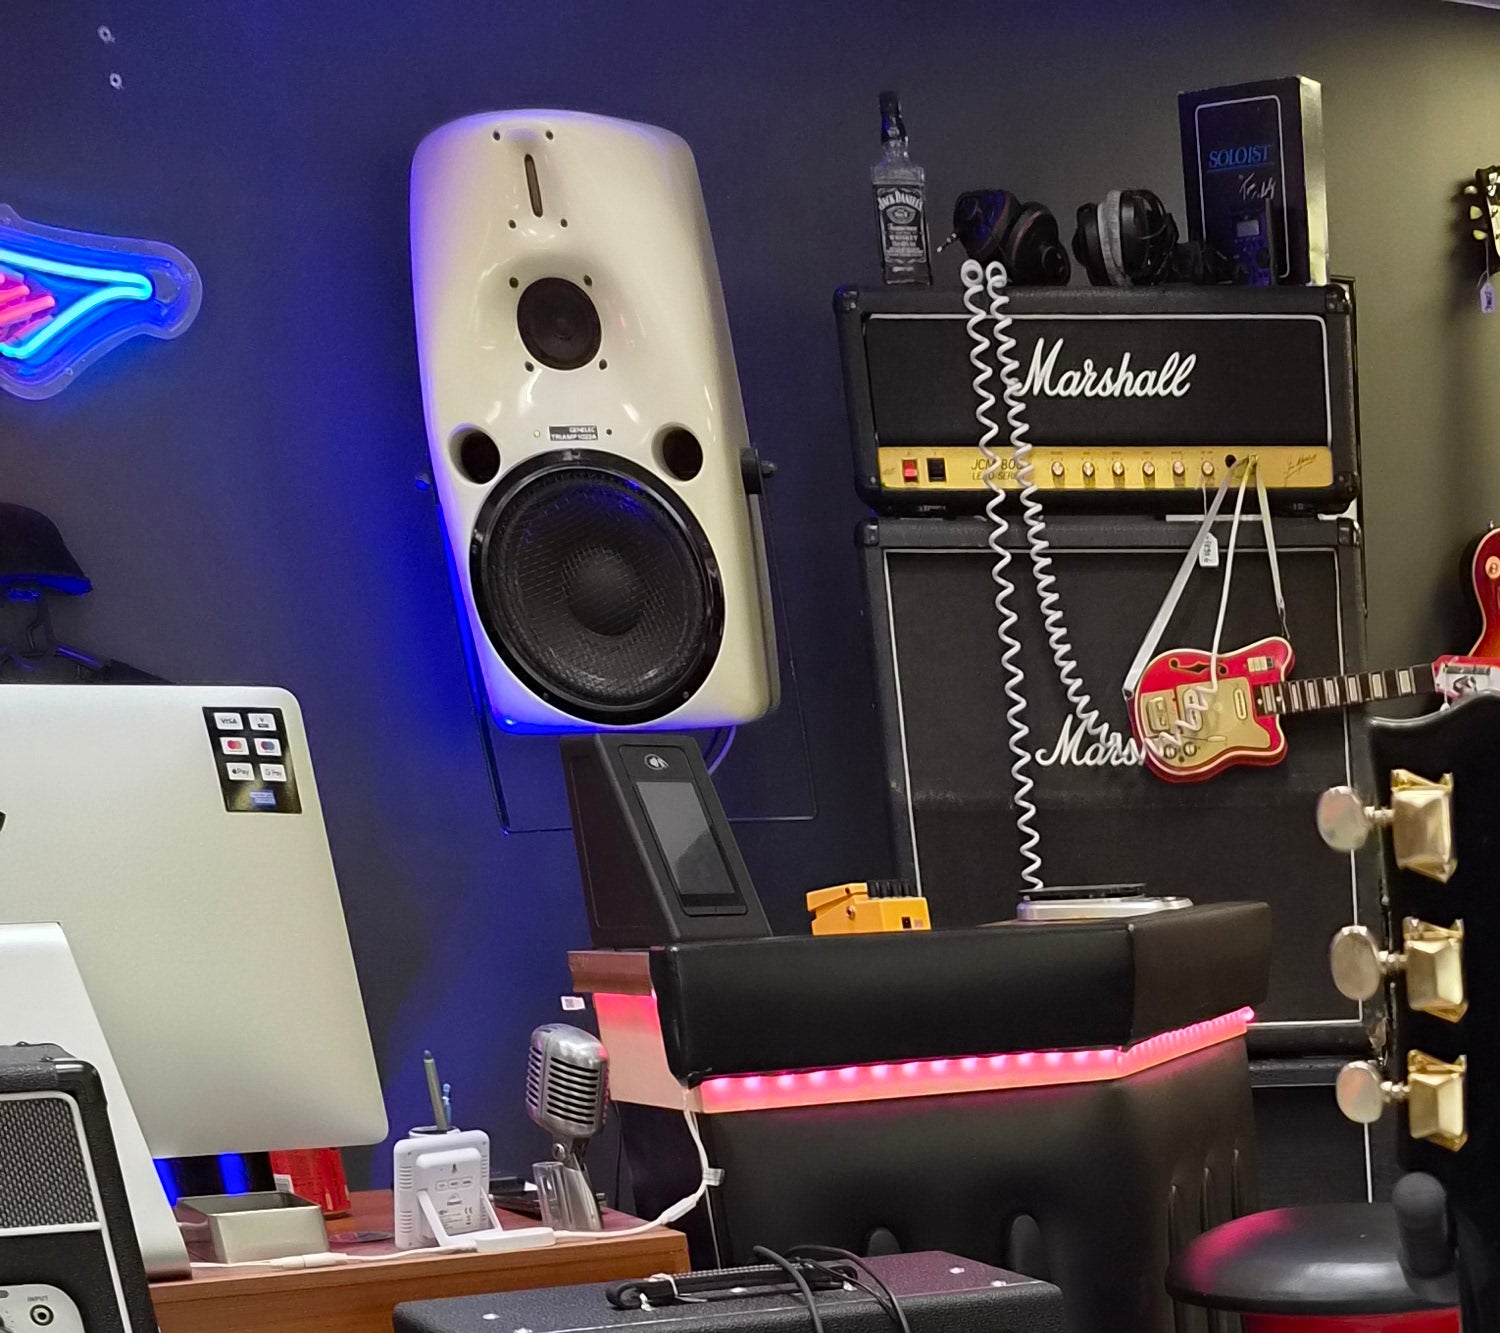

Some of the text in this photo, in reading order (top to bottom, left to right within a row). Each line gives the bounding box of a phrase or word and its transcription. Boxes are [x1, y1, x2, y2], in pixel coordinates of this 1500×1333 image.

[1208, 145, 1270, 168] SOLOIST
[1012, 337, 1197, 397] Marshall
[971, 472, 995, 481] LED
[1035, 713, 1146, 767] Mars
